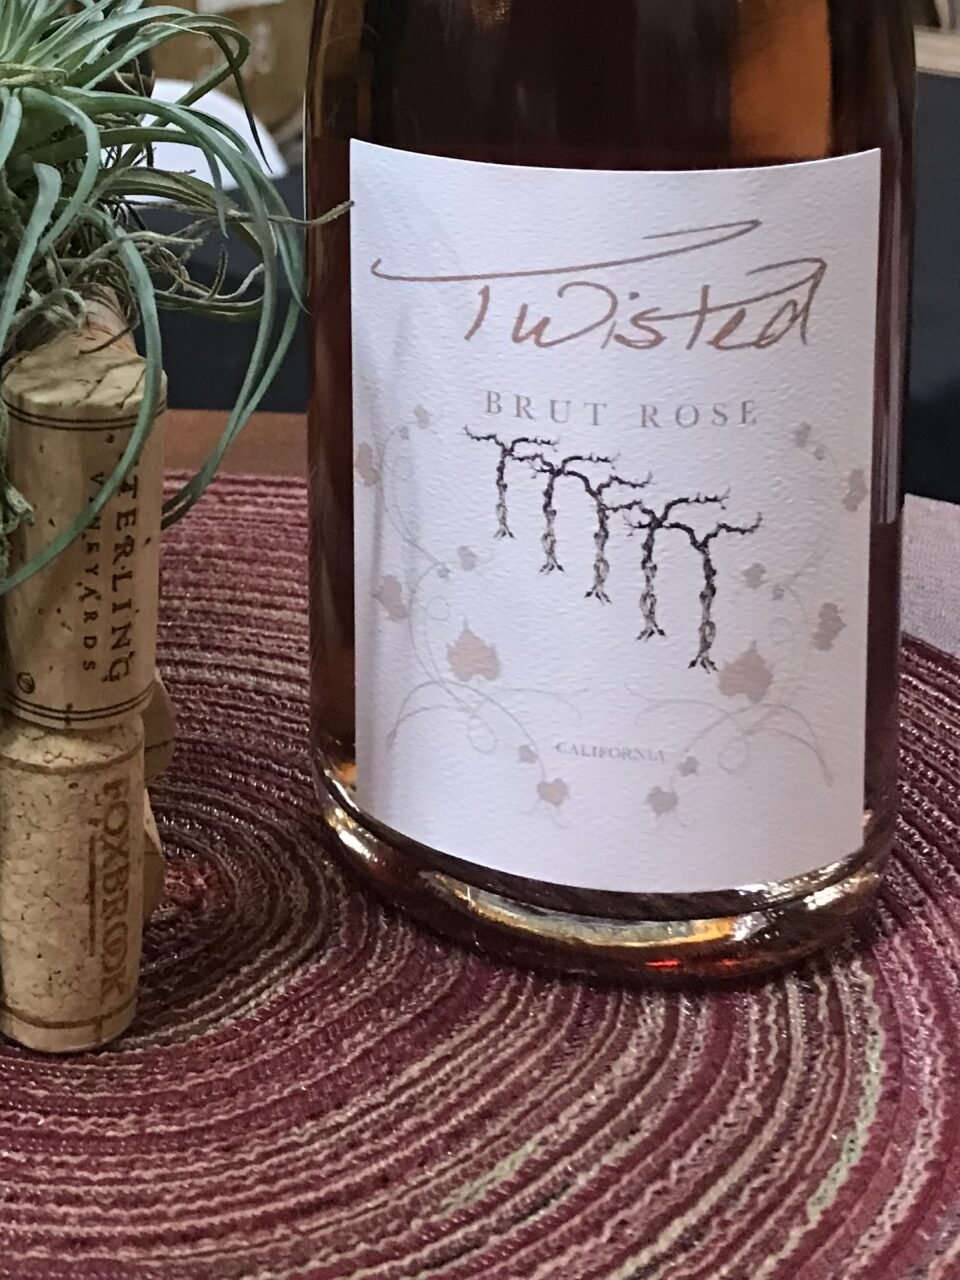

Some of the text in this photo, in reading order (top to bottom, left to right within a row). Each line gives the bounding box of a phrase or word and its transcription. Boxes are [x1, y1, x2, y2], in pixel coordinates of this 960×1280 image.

[371, 219, 827, 351] Twisted
[485, 390, 758, 428] BRUT ROSE
[555, 741, 665, 761] CALIFORNIA
[99, 776, 130, 997] FOXBROOK
